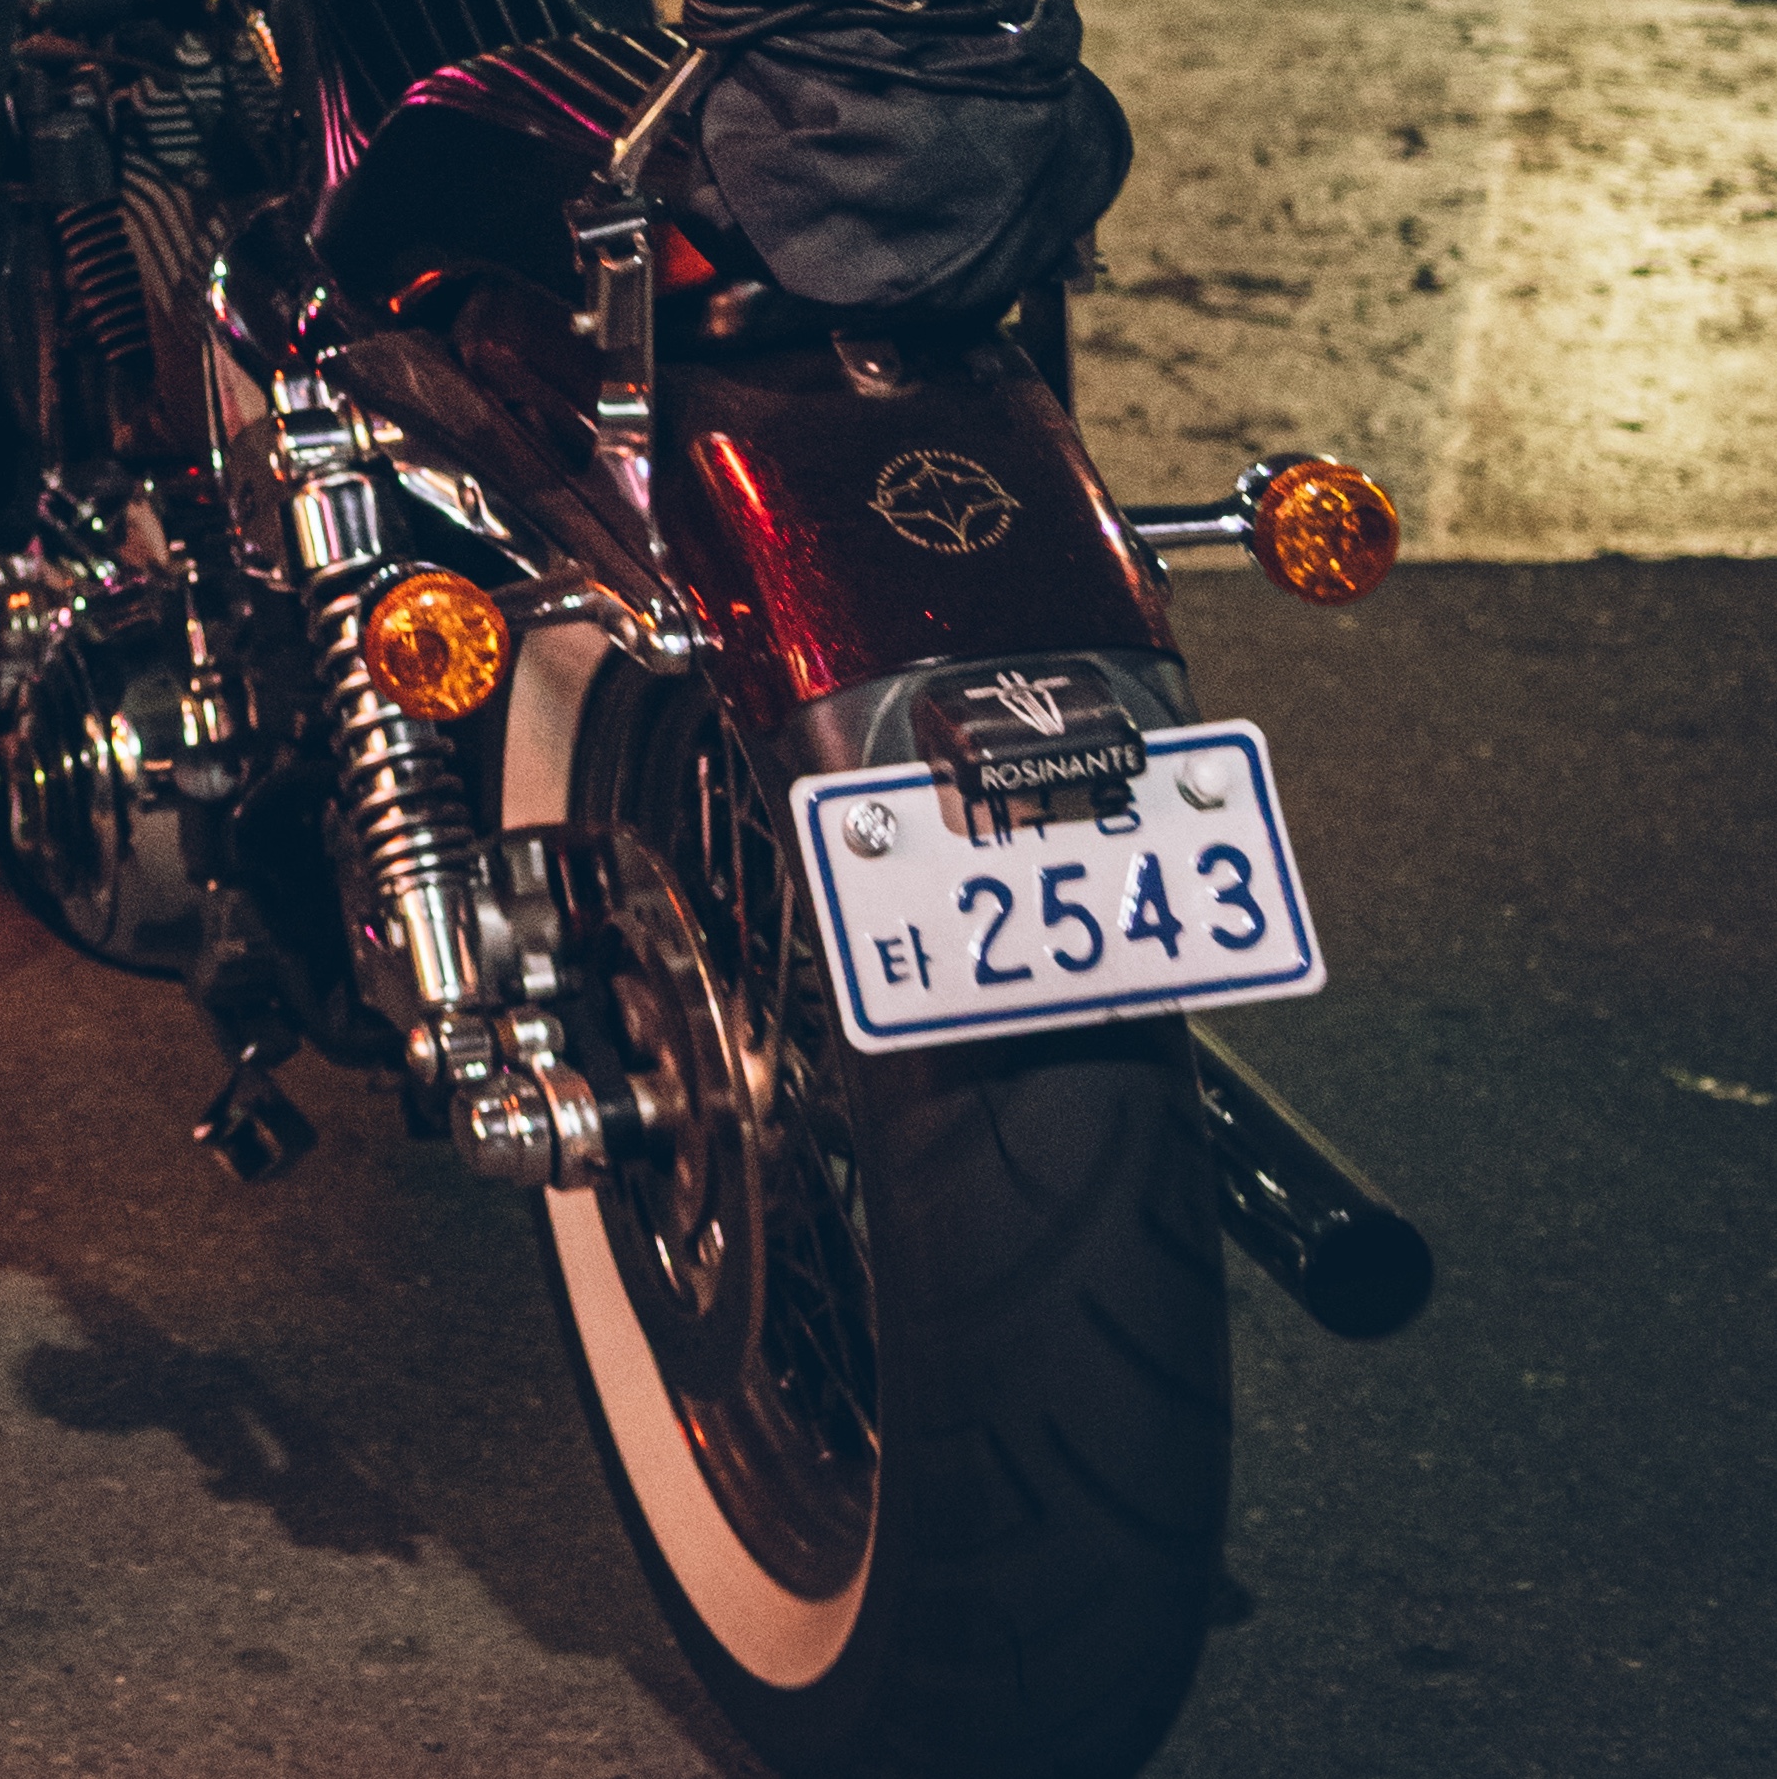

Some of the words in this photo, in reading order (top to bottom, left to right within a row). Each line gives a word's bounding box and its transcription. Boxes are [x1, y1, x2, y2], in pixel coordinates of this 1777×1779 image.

[981, 744, 1139, 791] ROSINANTE
[872, 924, 930, 989] 타
[957, 844, 1266, 986] 2543
